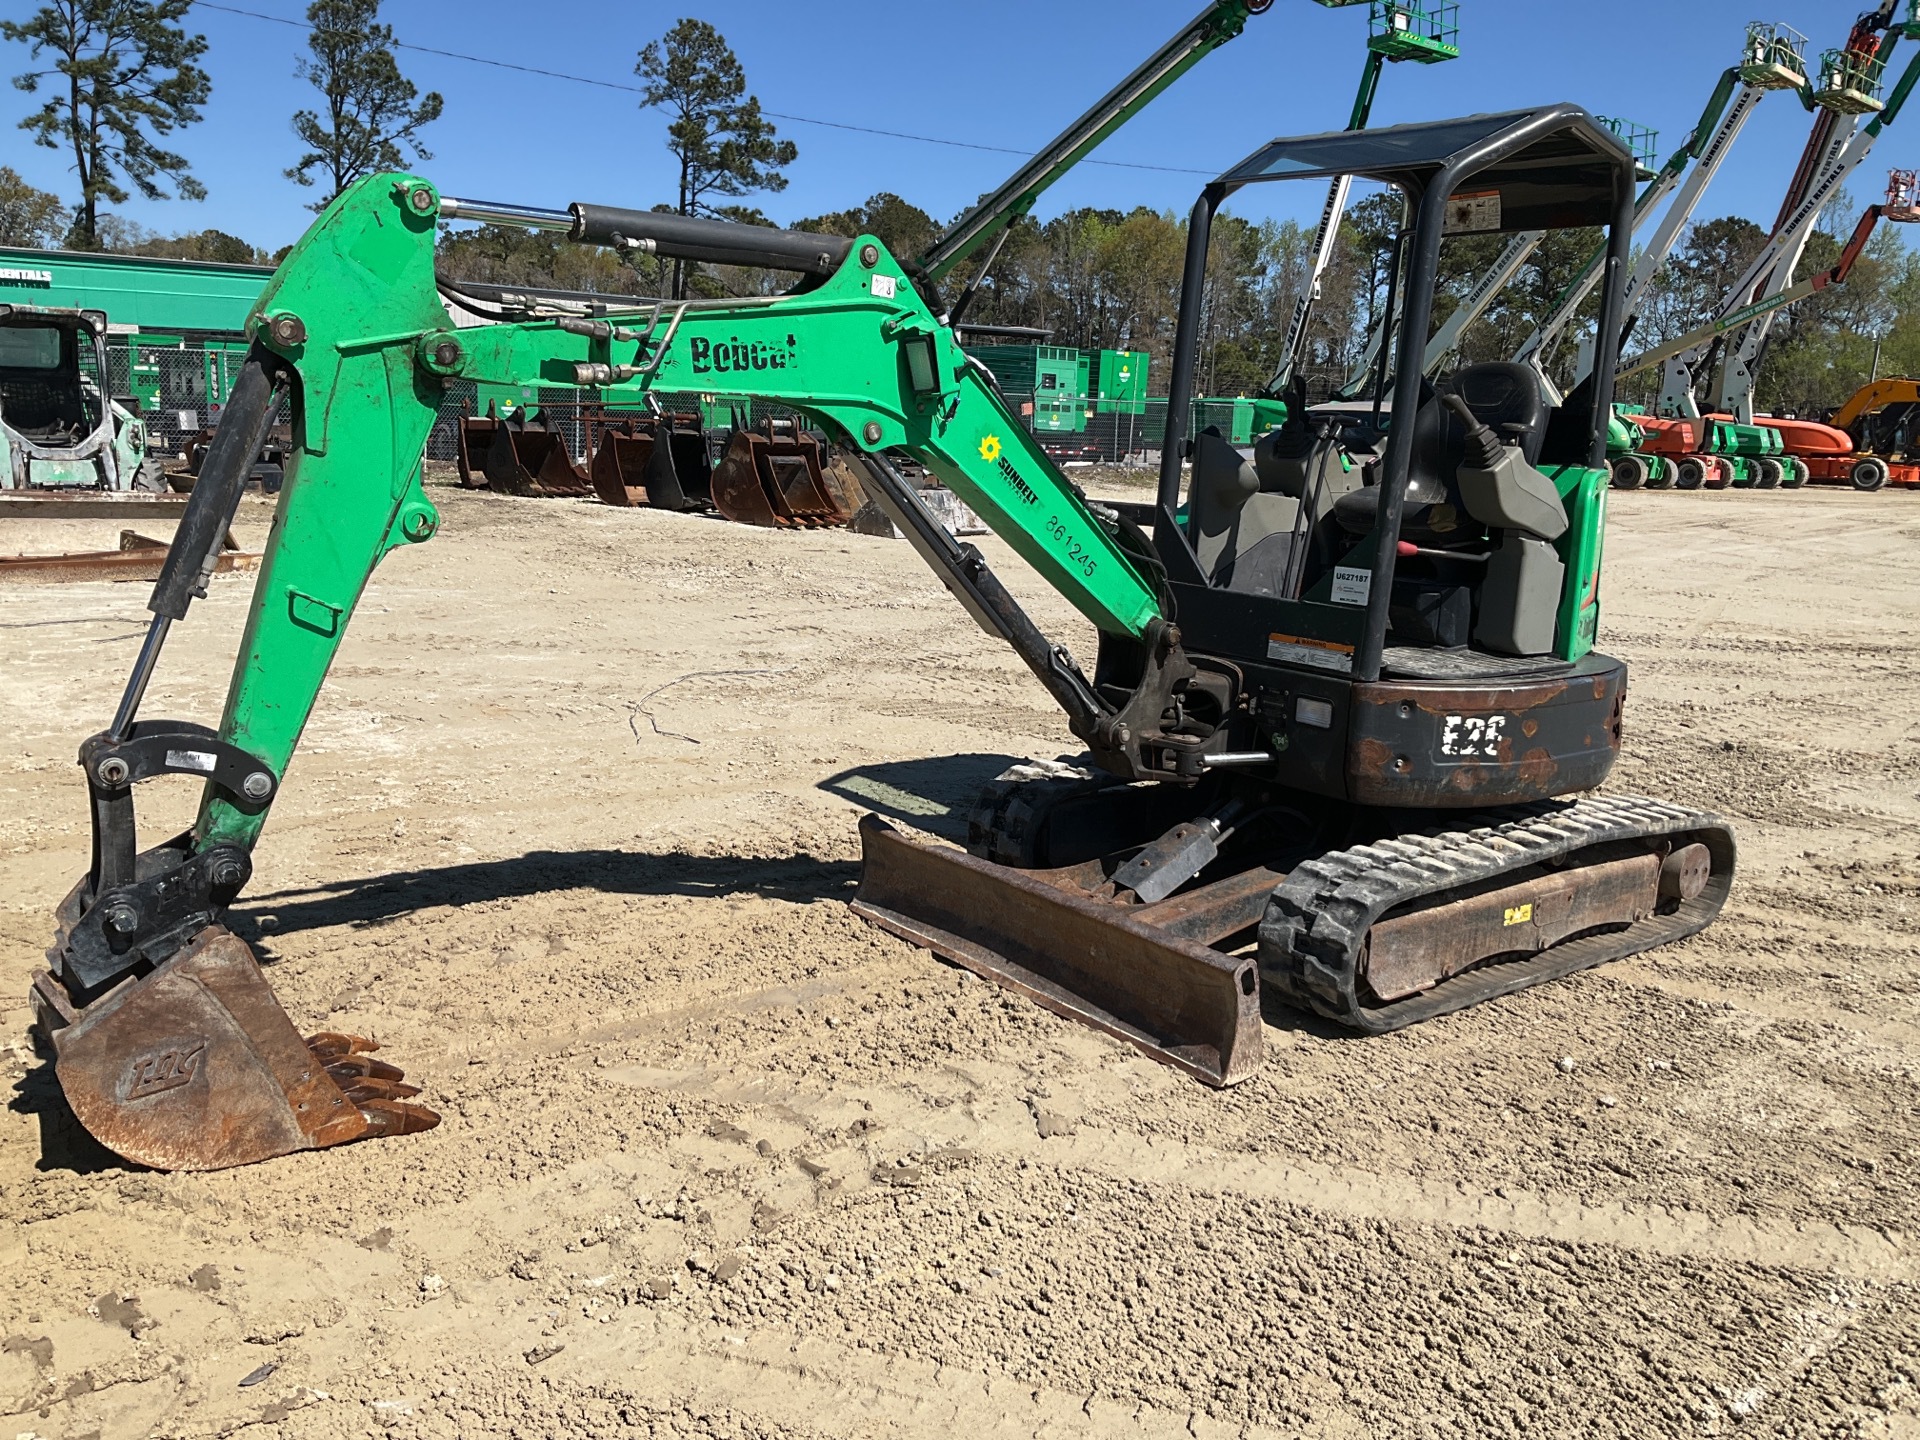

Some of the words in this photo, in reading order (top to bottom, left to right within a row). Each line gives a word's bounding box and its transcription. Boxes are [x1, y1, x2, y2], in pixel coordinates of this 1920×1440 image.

[1702, 130, 1727, 168] SUNBELT
[1724, 91, 1751, 131] RENTALS
[1784, 199, 1816, 235] SUNBELT
[1812, 163, 1845, 200] RENTALS
[1312, 209, 1331, 255] SUNBELT
[1469, 269, 1499, 304] SUNBELT
[1497, 234, 1527, 271] RENTALS
[1624, 275, 1637, 298] LIFT
[1287, 324, 1297, 348] JLG
[1293, 295, 1305, 324] LIFT
[1724, 308, 1754, 327] SUNBELT
[1754, 295, 1786, 313] RENTALS
[1623, 358, 1641, 371] LIFT
[998, 456, 1039, 505] SUNBELT
[1046, 515, 1097, 577] 861245
[1336, 572, 1368, 582] U627187
[1301, 638, 1327, 649] WARNING
